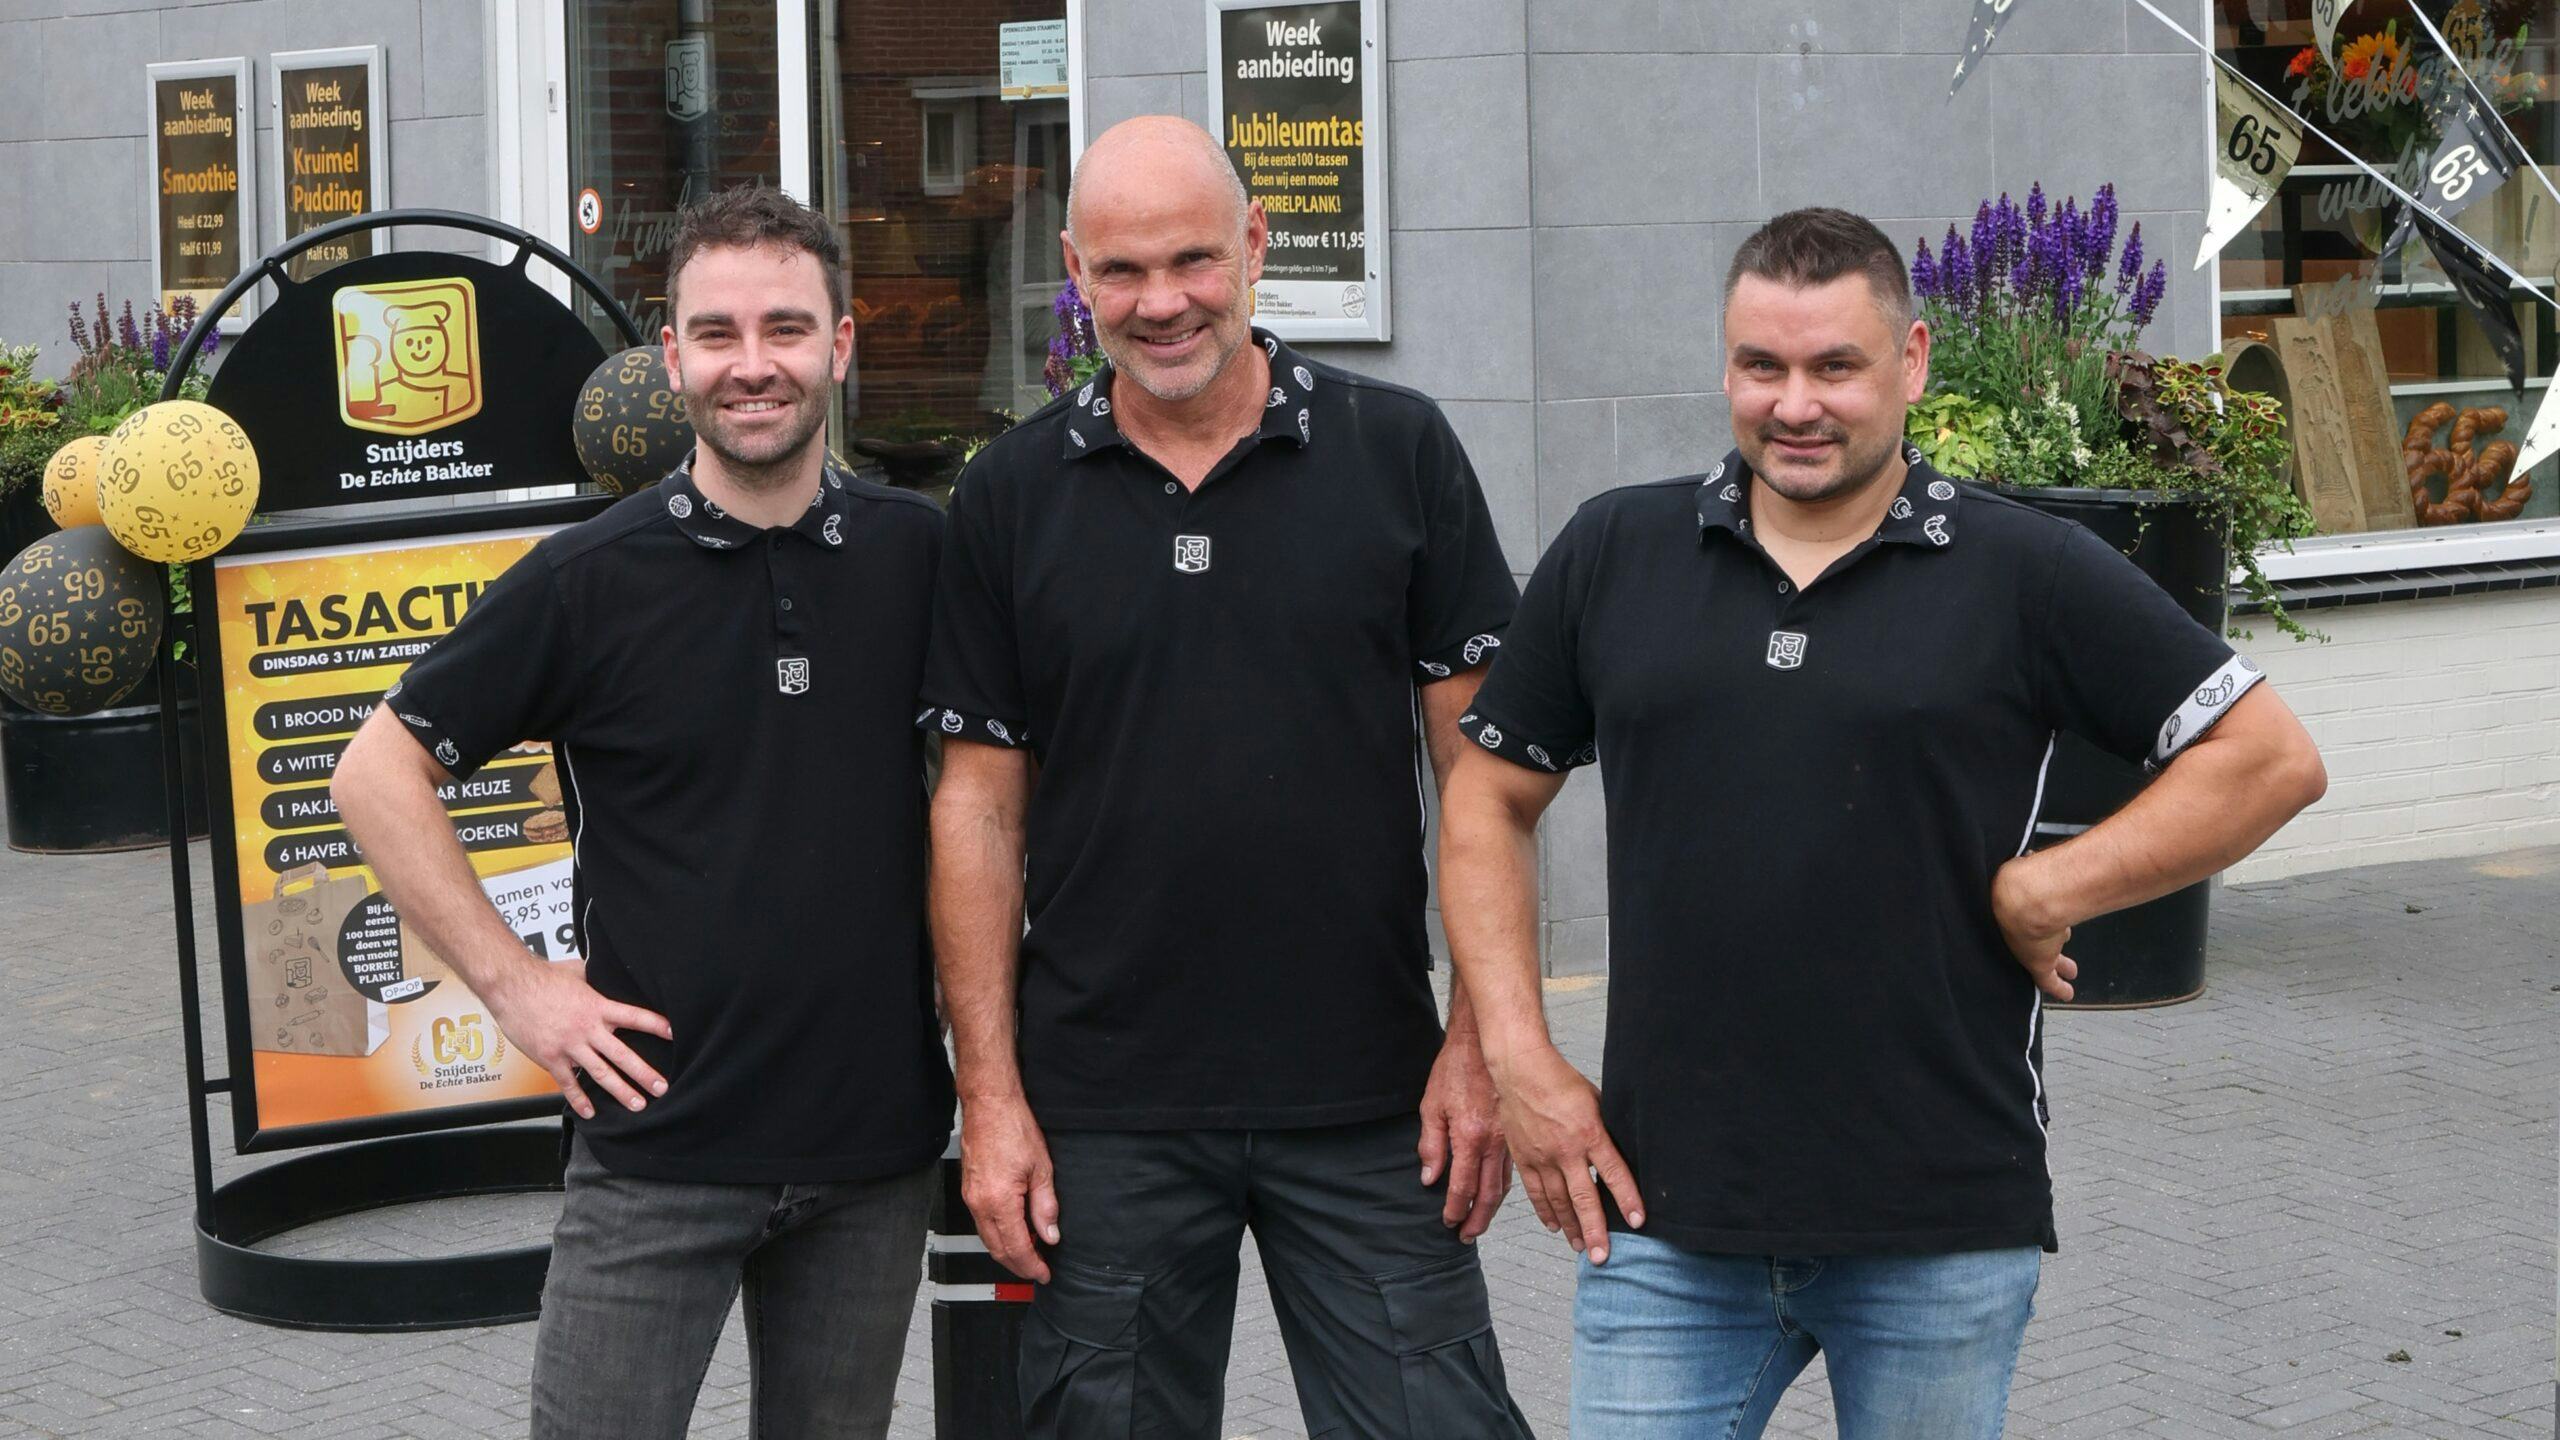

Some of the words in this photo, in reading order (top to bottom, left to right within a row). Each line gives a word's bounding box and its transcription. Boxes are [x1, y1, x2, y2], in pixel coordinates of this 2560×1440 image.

[1266, 18, 1322, 46] Week
[1237, 50, 1354, 83] aanbieding
[180, 89, 215, 111] Week
[306, 80, 341, 103] Week
[164, 112, 232, 138] aanbieding
[289, 106, 363, 131] aanbieding
[1229, 112, 1363, 147] Jubileumtas
[293, 143, 359, 175] Kruimel
[2229, 114, 2281, 175] 65
[1244, 153, 1256, 170] Bij
[1258, 153, 1269, 167] de
[1315, 153, 1348, 166] tassen
[2431, 144, 2490, 201] 65
[163, 164, 237, 194] Smoothie
[1252, 171, 1274, 186] doen
[1276, 171, 1288, 190] wij
[1290, 177, 1306, 186] een
[1308, 171, 1339, 186] mooie
[293, 183, 363, 216] Pudding
[177, 215, 195, 229] Heel
[180, 242, 195, 256] Half
[307, 246, 322, 261] Half
[1267, 231, 1290, 249] 5,95
[1292, 235, 1319, 248] voor
[1332, 231, 1364, 250] 11,95
[620, 352, 652, 385] 65
[583, 387, 605, 421] 65
[117, 411, 148, 444] 65
[166, 414, 203, 445] 65
[220, 422, 249, 450] 65
[612, 424, 648, 457] 65
[366, 439, 464, 464] Snijders
[58, 454, 78, 480] 65
[108, 457, 140, 494] 65
[166, 451, 203, 491] 65
[214, 461, 244, 497] 65
[340, 473, 366, 489] De
[370, 467, 421, 487] Echte
[425, 461, 493, 481] Bakker
[135, 506, 171, 539] 65
[183, 526, 222, 555] 65
[22, 545, 54, 574] 65
[64, 568, 105, 603] 65
[117, 598, 147, 638] 65
[244, 579, 499, 647] TASACTI
[28, 611, 71, 646] 65
[2, 647, 25, 689] 65
[80, 646, 114, 685] 65
[263, 653, 329, 671] DINSDAG
[333, 653, 343, 664] 3
[347, 648, 374, 663] T/M
[379, 642, 438, 659] ZATERD
[271, 715, 277, 729] 1
[285, 708, 344, 728] BROOD
[350, 705, 374, 720] NA
[272, 760, 283, 773] 6
[287, 753, 335, 772] WITTE
[278, 804, 284, 818] 1
[462, 779, 511, 798] KEUZE
[280, 848, 290, 863] 6
[295, 842, 347, 861] HAVER
[495, 884, 544, 905] amen
[551, 876, 572, 890] va
[365, 916, 396, 926] eerste
[366, 904, 381, 915] Bij
[345, 931, 363, 940] 100
[365, 927, 397, 938] tassen
[355, 940, 381, 950] doen
[383, 939, 398, 947] we
[347, 954, 365, 962] een
[367, 949, 399, 960] mooie
[354, 961, 400, 973] BORREL-
[420, 1081, 433, 1090] De
[436, 1078, 463, 1088] Echte
[466, 1073, 502, 1084] Bakker
[435, 1064, 486, 1078] Snijders
